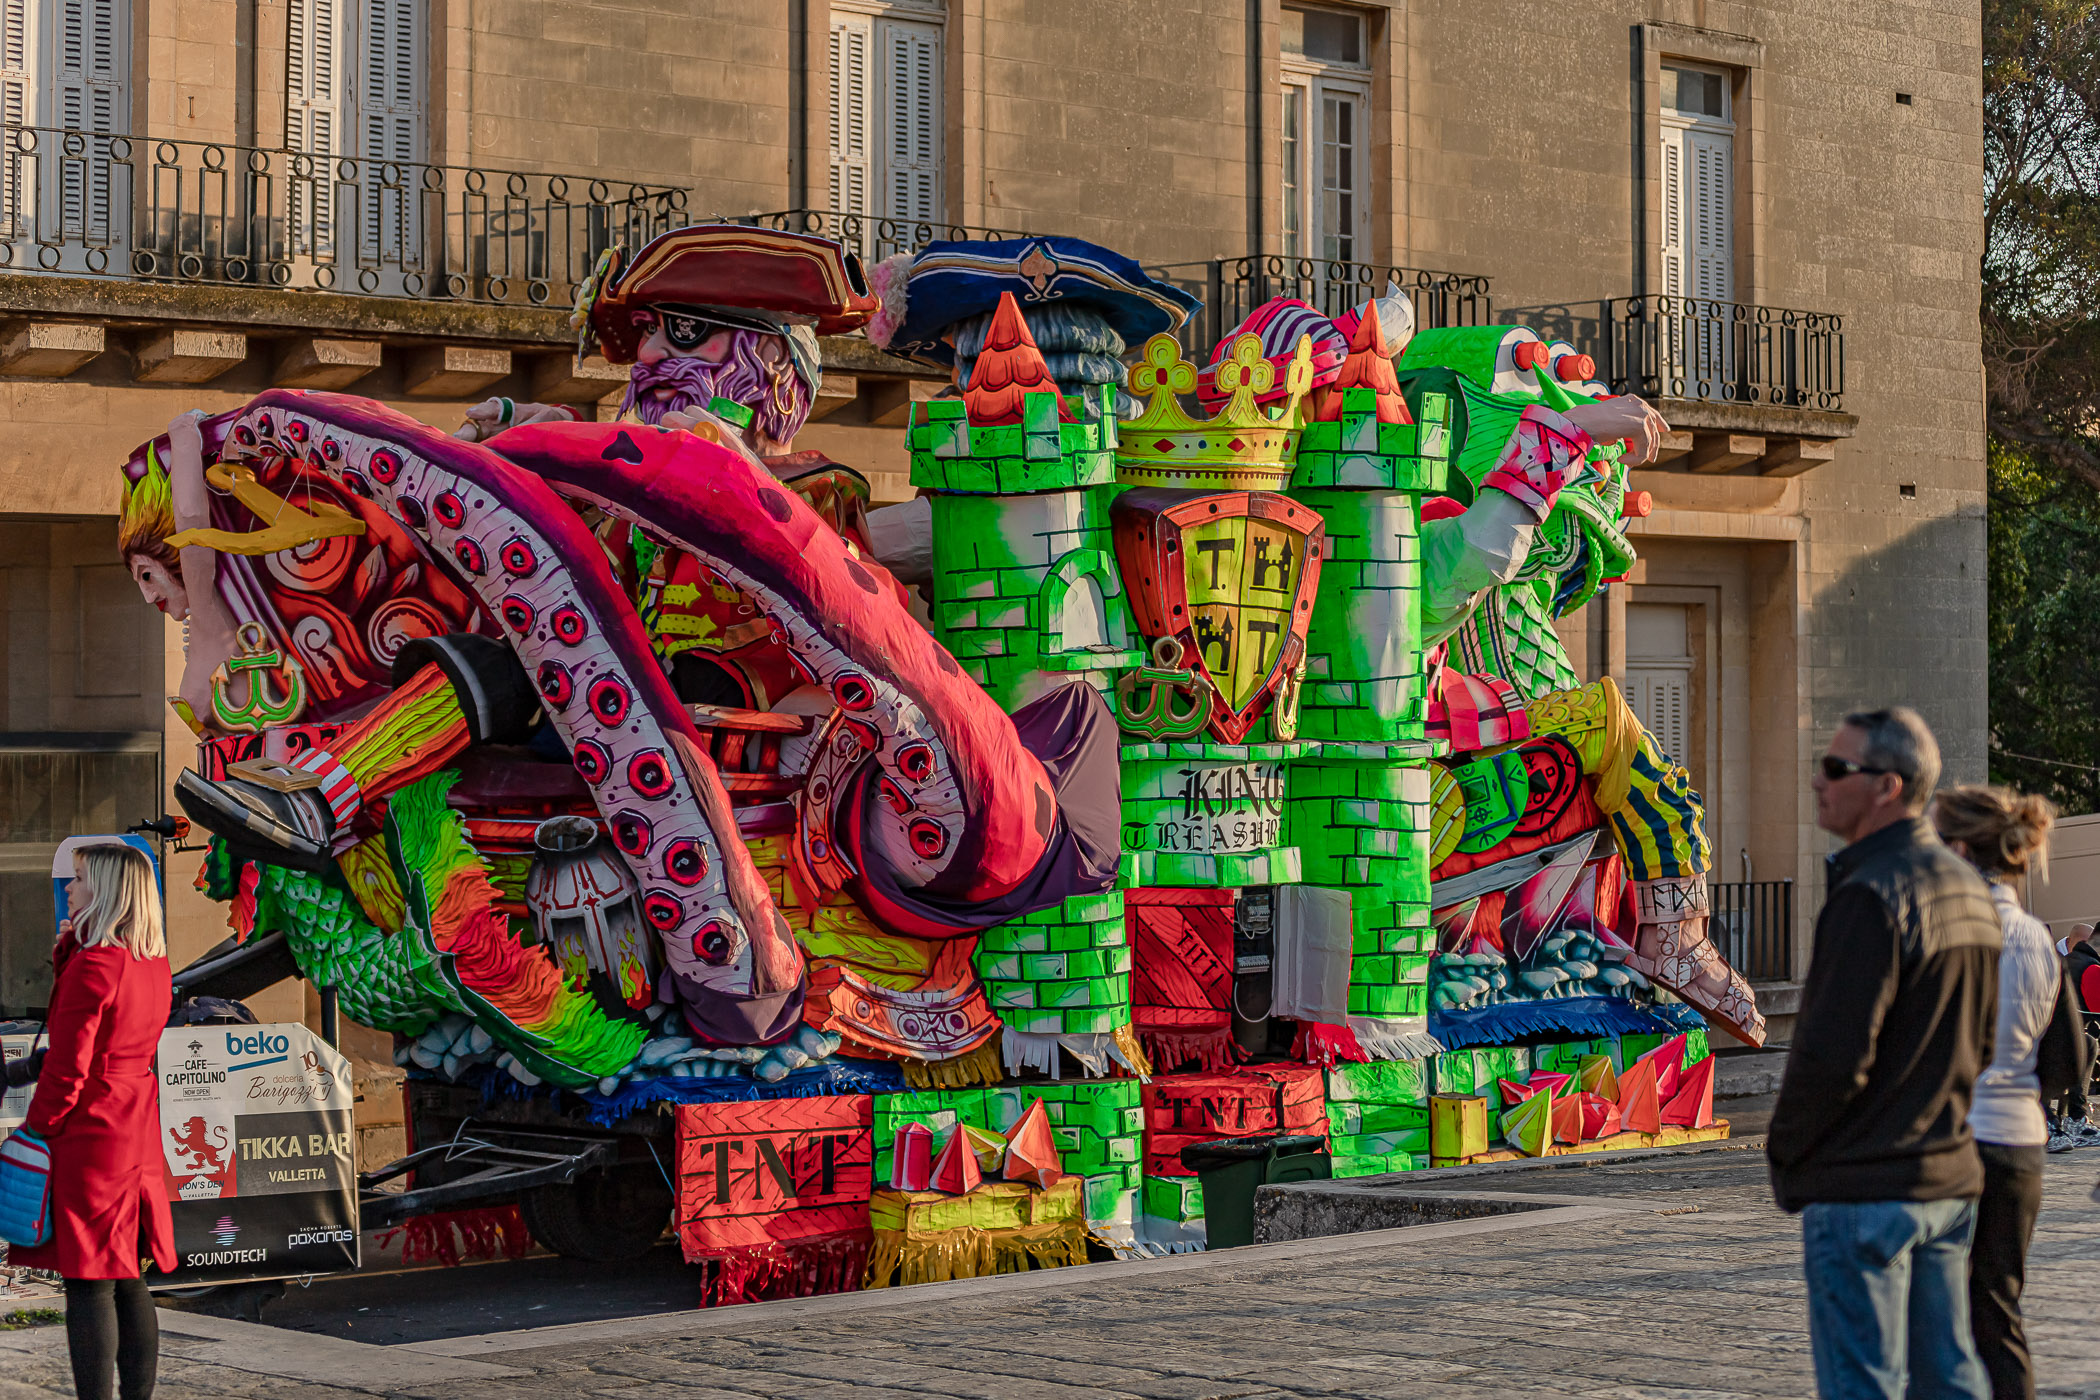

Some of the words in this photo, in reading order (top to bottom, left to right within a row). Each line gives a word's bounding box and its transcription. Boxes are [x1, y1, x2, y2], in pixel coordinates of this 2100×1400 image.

[1248, 620, 1280, 675] T
[1177, 762, 1285, 822] KING
[226, 1031, 289, 1055] beko
[185, 1059, 207, 1070] CAFE
[300, 1050, 318, 1072] 10
[166, 1071, 226, 1085] CAPITOLINO
[273, 1074, 304, 1083] dolceria
[247, 1076, 317, 1105] Barigozzi
[1163, 1096, 1252, 1130] TNT
[239, 1136, 302, 1161] TIKKA
[308, 1133, 351, 1157] BAR
[269, 1169, 326, 1183] VALLETTA
[700, 1135, 848, 1205] TNT
[177, 1181, 205, 1190] LION'S
[207, 1180, 225, 1188] DEN
[288, 1230, 353, 1250] paxanas
[187, 1248, 267, 1267] SOUNDTECH
